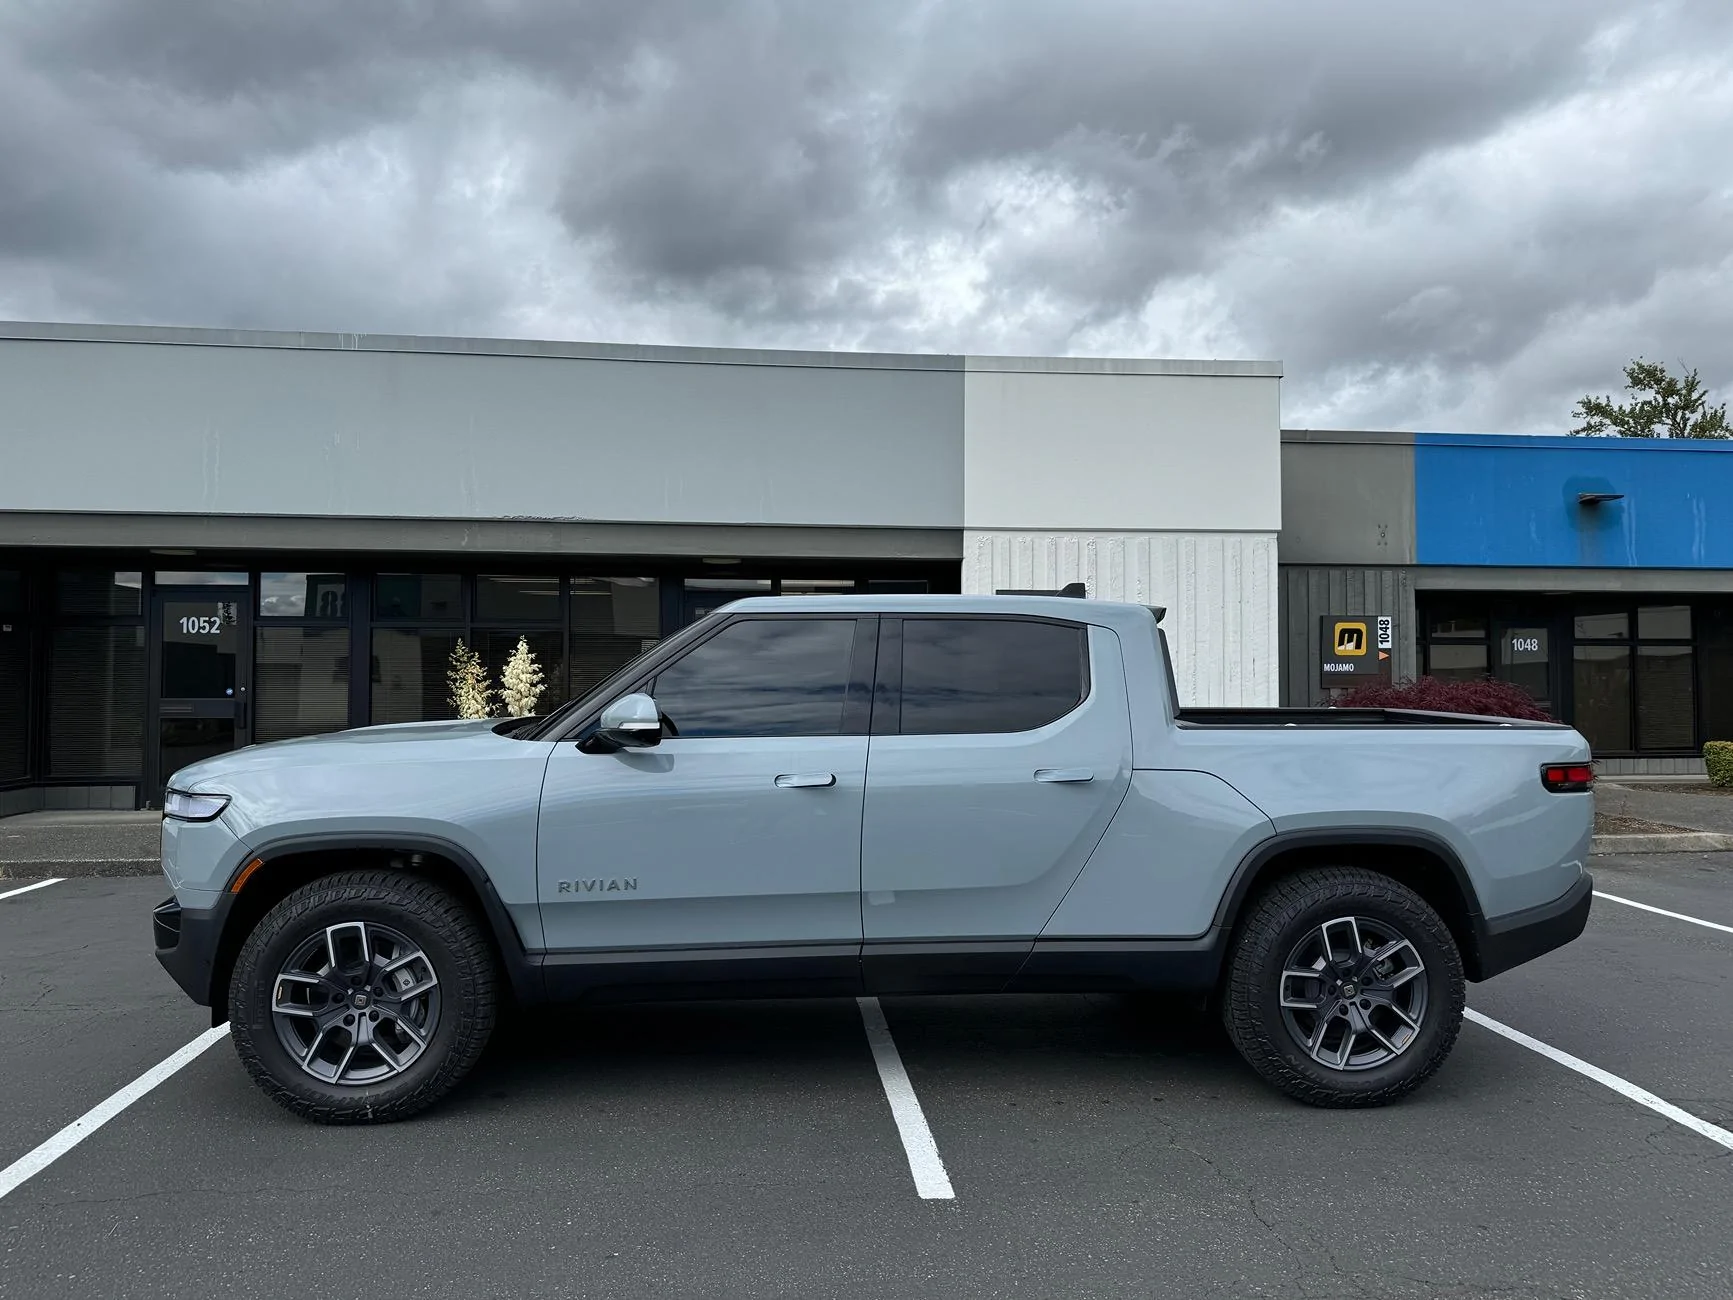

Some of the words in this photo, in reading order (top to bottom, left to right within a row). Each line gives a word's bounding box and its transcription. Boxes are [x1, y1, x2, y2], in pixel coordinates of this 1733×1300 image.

[179, 616, 221, 634] 1052
[1378, 619, 1390, 645] 1048
[1511, 638, 1539, 651] 1048
[1323, 663, 1355, 672] MOJAMO
[557, 878, 638, 893] RIVIAN
